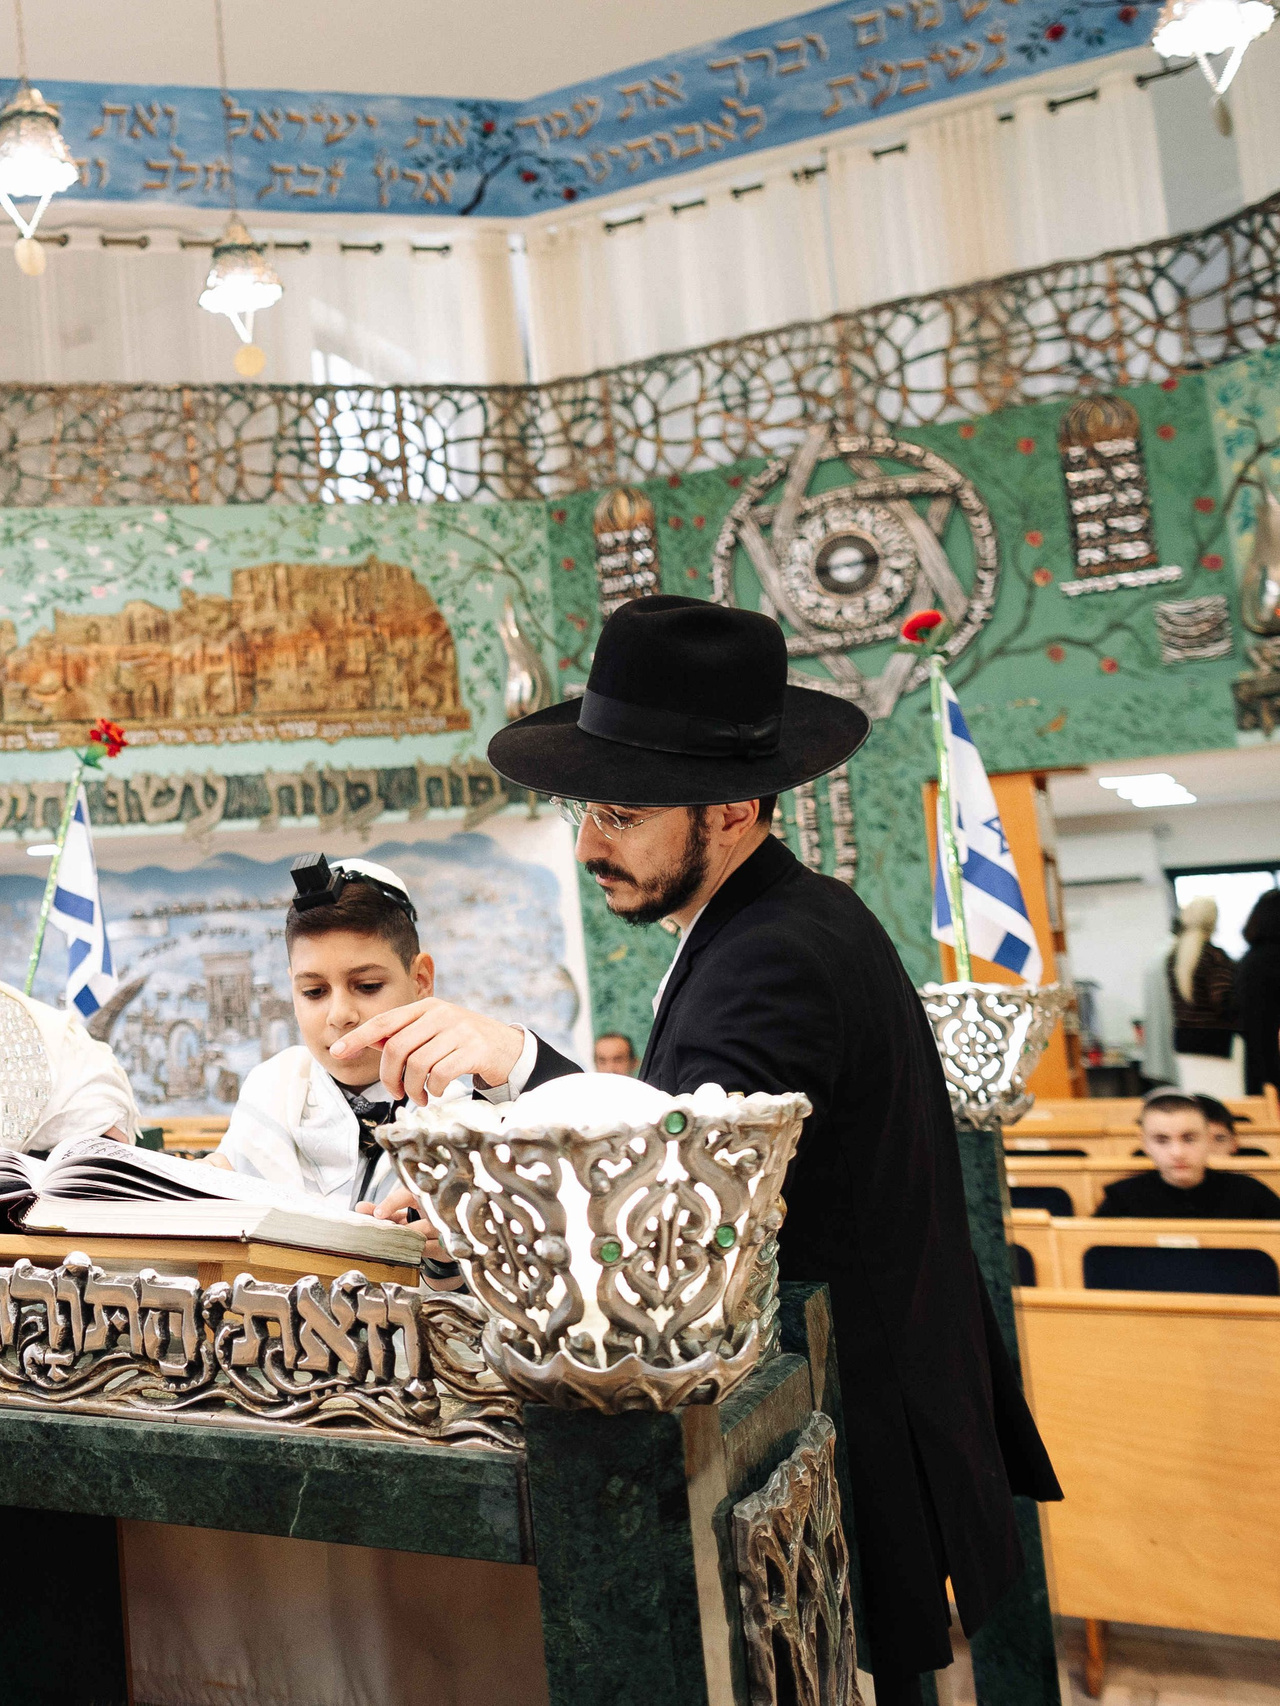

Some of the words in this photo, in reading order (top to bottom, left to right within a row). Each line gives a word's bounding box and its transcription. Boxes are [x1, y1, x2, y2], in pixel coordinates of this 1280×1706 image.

[706, 31, 829, 98] וברך
[821, 20, 1012, 119] נשבעת
[90, 101, 177, 139] ואת
[223, 94, 377, 148] ישראל
[514, 96, 602, 151] עמך
[617, 72, 687, 122] את
[404, 114, 471, 150] את
[573, 97, 768, 185] לאבותינו
[141, 142, 233, 193] חלב
[257, 156, 347, 200] זבת
[373, 148, 455, 208] ארץ
[231, 1270, 425, 1384] וזאת
